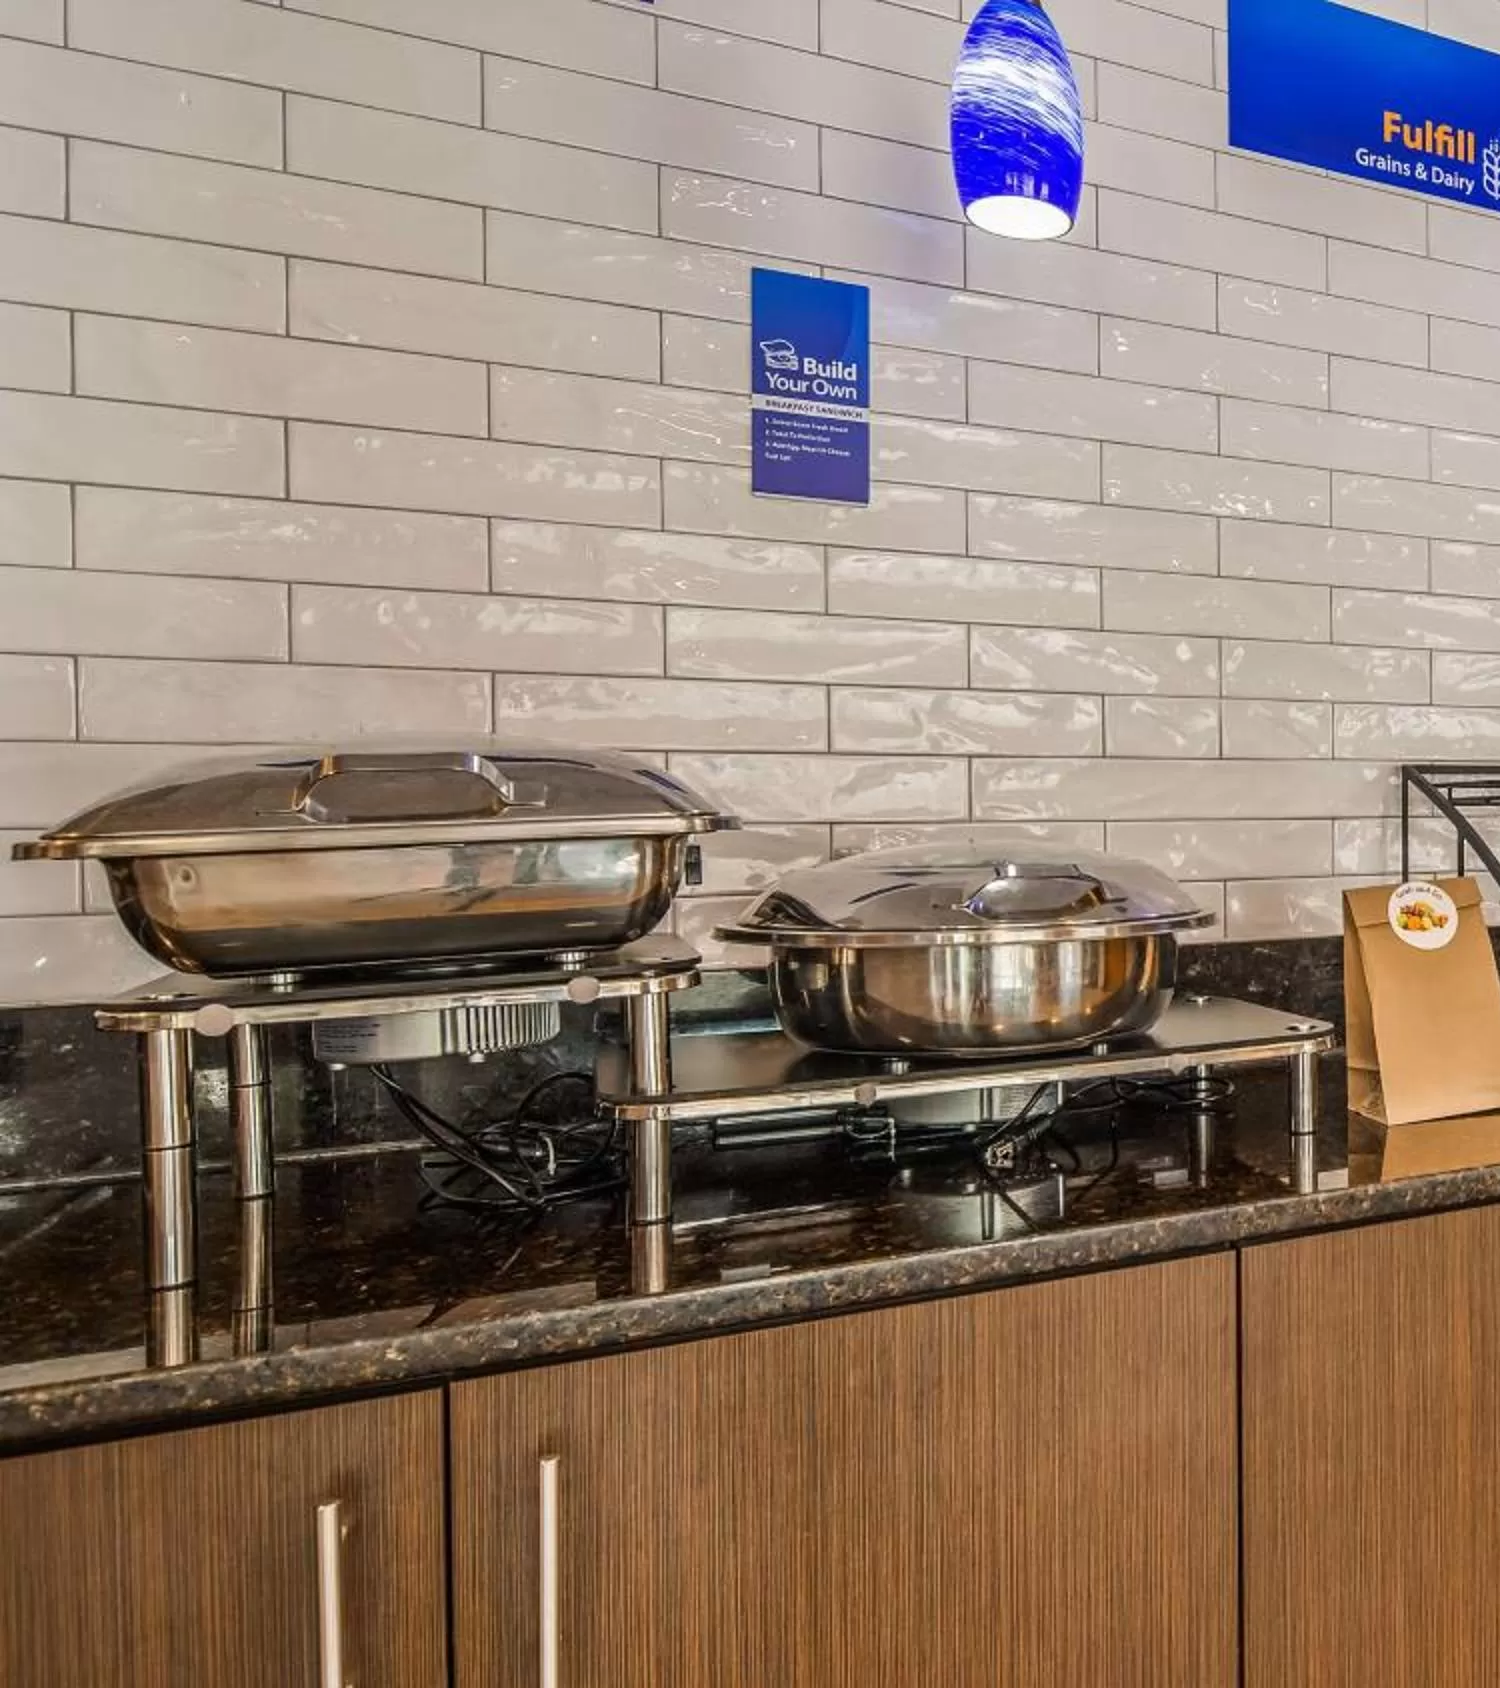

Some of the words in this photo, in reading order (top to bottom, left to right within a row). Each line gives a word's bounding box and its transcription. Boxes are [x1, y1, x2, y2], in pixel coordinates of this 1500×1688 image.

[1383, 110, 1476, 165] Fulfill
[1355, 147, 1411, 177] Grains
[1415, 161, 1428, 181] &
[1431, 166, 1475, 195] Dairy
[803, 357, 856, 381] Build
[765, 371, 810, 392] Your
[812, 379, 857, 400] Own
[765, 400, 814, 412] BREAKFAST
